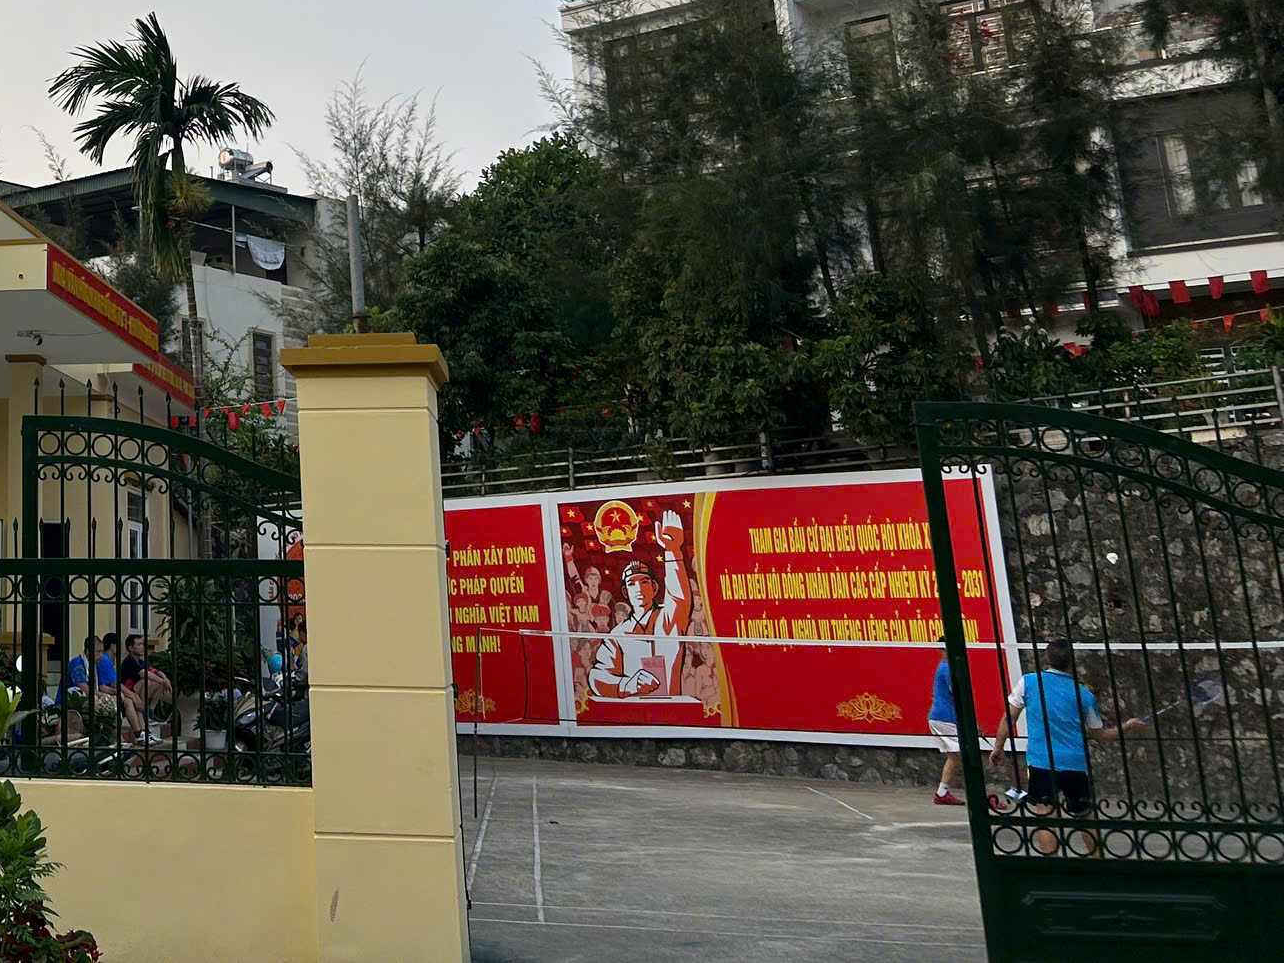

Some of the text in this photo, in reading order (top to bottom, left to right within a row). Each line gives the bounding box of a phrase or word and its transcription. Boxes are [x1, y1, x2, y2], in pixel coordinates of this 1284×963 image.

[748, 527, 773, 554] THAM
[773, 527, 789, 553] GIA
[788, 517, 806, 553] BẦU
[806, 517, 819, 553] CỬ
[819, 525, 835, 557] ĐẠI
[835, 513, 856, 552] BIỂU
[856, 515, 881, 554] QUỐC
[880, 517, 898, 557] HỘI
[896, 517, 923, 551] KHÓA
[452, 544, 536, 568] PHẦN XÂY DỰNG
[459, 574, 487, 595] PHÁP
[489, 571, 525, 596] QUYỀN
[719, 568, 732, 600] VÀ
[731, 574, 747, 605] ĐẠI
[747, 562, 766, 600] BIỂU
[766, 567, 782, 605] HỘI
[781, 564, 806, 599] ĐỒNG
[805, 566, 831, 599] NHÂN
[830, 566, 850, 599] DÂN
[849, 566, 868, 599] CÁC
[868, 561, 886, 599] CẤP
[887, 565, 918, 605] NHIỆM
[918, 565, 932, 599] KỲ
[961, 569, 986, 598] 2031
[454, 603, 487, 624] NGHĨA
[488, 602, 511, 627] VIỆT
[513, 604, 540, 623] NAM
